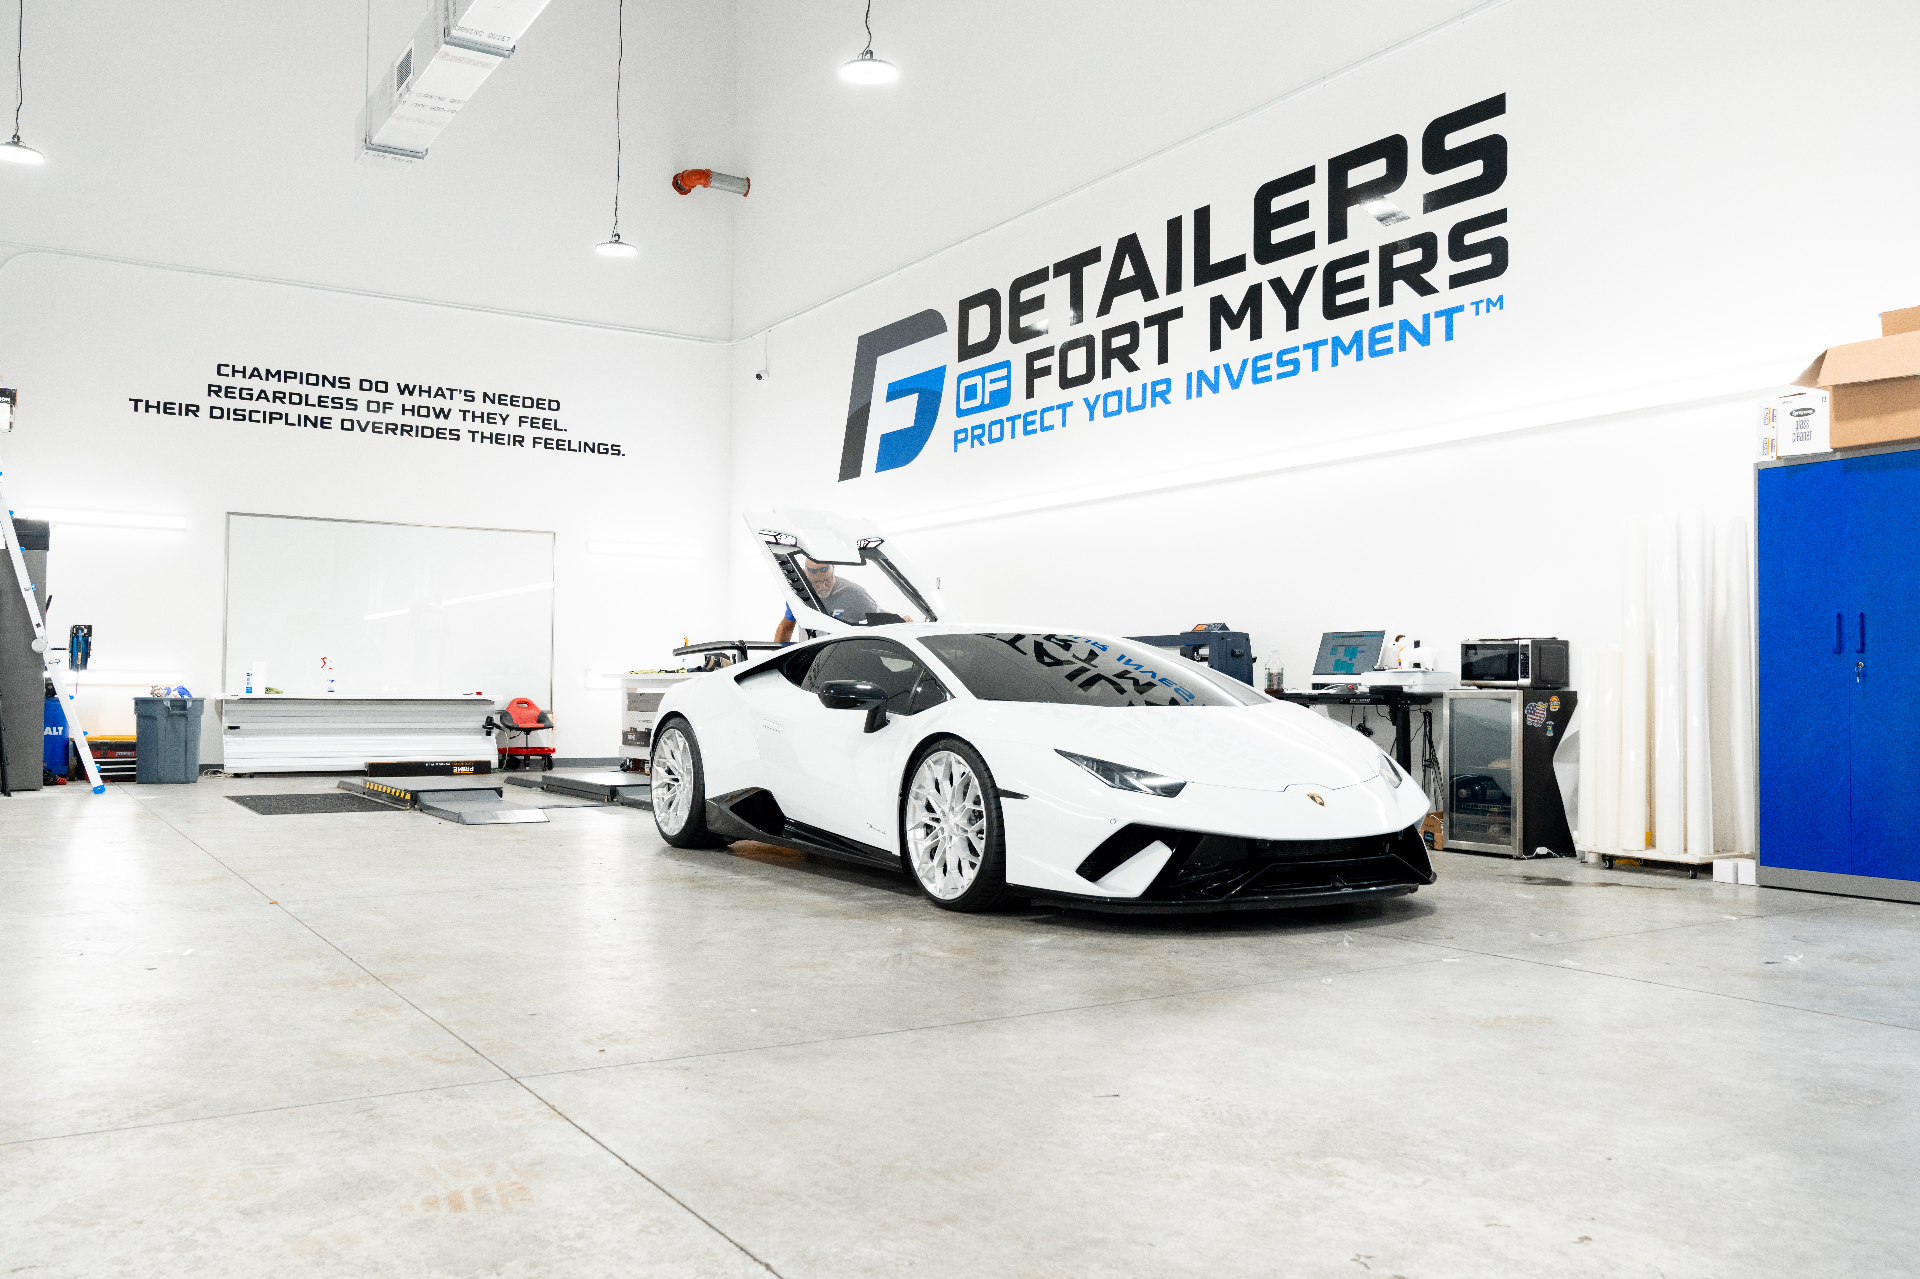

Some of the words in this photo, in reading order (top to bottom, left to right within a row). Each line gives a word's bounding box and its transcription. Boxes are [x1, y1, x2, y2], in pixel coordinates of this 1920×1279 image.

[957, 93, 1508, 363] DETAILERS
[959, 366, 1008, 411] OF
[1026, 305, 1184, 400] FORT
[1210, 208, 1509, 353] MYERS
[207, 383, 358, 412] REGARDLESS
[367, 400, 395, 414] OF
[402, 403, 452, 421] HOW
[459, 408, 510, 426] THEY
[519, 415, 568, 433] FEEL.
[217, 364, 350, 390] CHAMPIONS
[359, 379, 389, 394] DO
[397, 383, 476, 403] WHAT'S
[483, 391, 561, 412] NEEDED
[953, 401, 1074, 453] PROTECT
[1082, 378, 1172, 422] YOUR
[129, 397, 200, 418] THEIR
[209, 405, 333, 430] DISCIPLINE
[341, 418, 461, 442] OVERRIDES
[468, 429, 525, 448] THEIR
[533, 436, 626, 457] FEELINGS.
[1792, 430, 1812, 442] cleaner
[1795, 418, 1810, 431] glass
